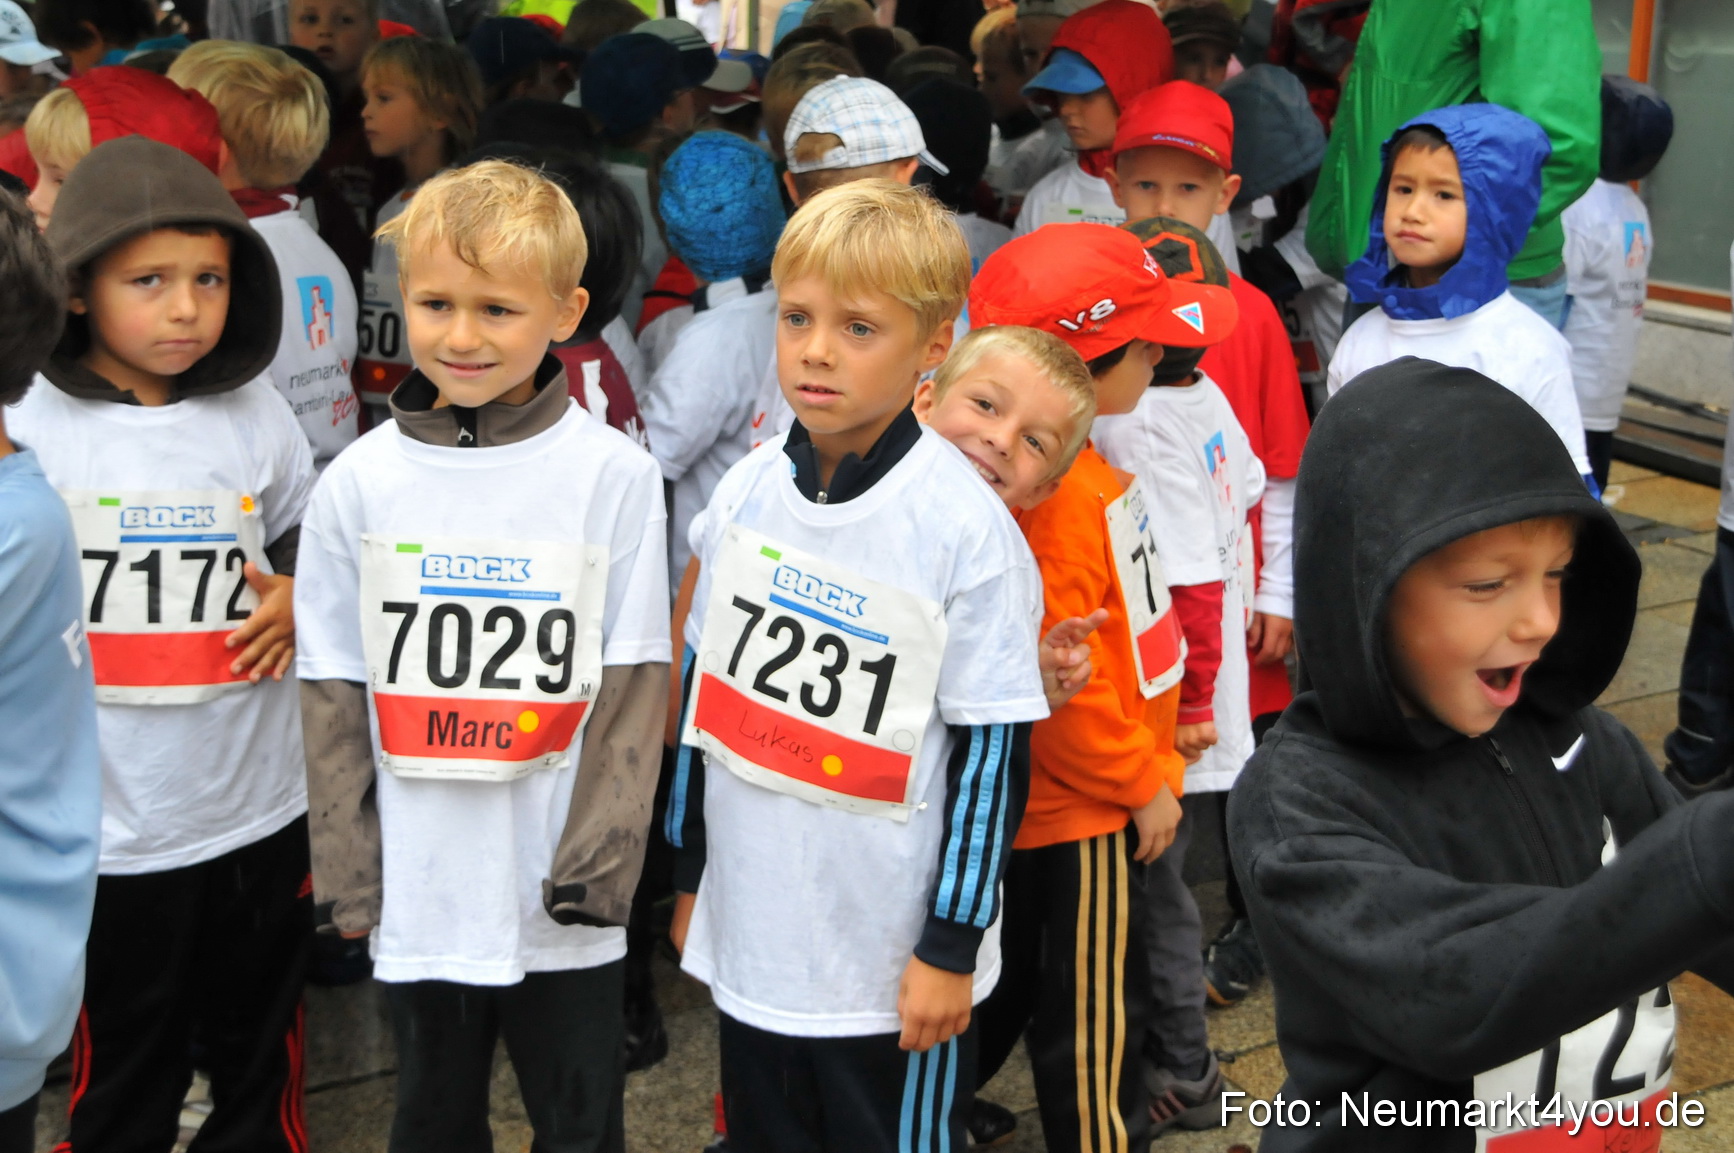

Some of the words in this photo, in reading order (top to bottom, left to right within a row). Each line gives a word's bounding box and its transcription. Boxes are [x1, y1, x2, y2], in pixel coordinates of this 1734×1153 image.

[120, 506, 216, 528] BOCK
[82, 547, 253, 624] 7172
[421, 554, 532, 583] BOCK
[773, 565, 868, 618] BOCK
[382, 601, 577, 694] 7029
[727, 594, 897, 736] 7231
[427, 709, 514, 750] Marc
[738, 710, 815, 765] Lukas
